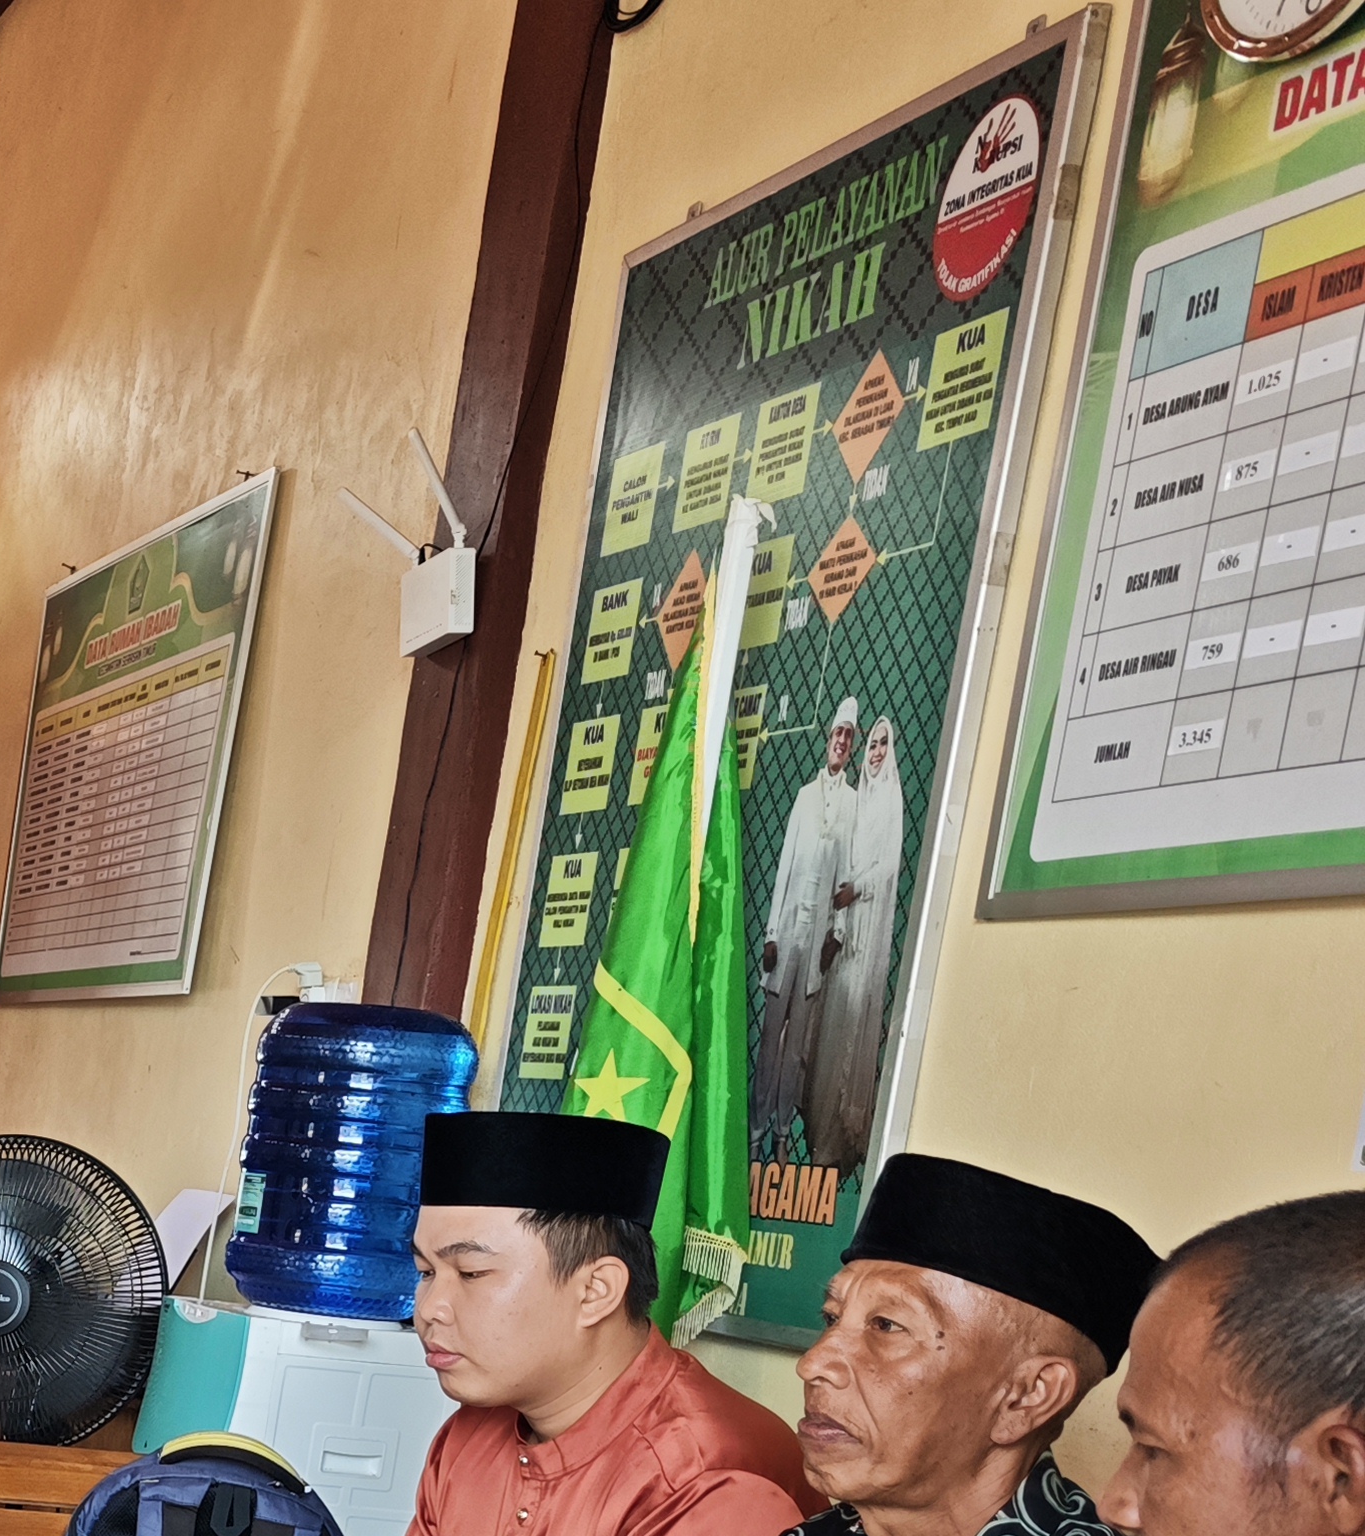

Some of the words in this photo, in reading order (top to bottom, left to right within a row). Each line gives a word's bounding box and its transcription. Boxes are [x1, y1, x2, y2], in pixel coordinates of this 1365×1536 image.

[1272, 48, 1365, 133] DATA
[944, 195, 966, 217] ZONA
[966, 169, 1015, 207] INTEGRITAS
[1015, 160, 1034, 183] KUA
[704, 222, 774, 310] ALUR
[774, 134, 949, 277] PELAYANAN
[937, 257, 958, 293] TOLAK
[957, 227, 1018, 294] GRATIFIKASI
[1317, 262, 1365, 303] KRISTEN
[736, 241, 887, 371] NIKAH
[1185, 285, 1220, 322] DESA
[1260, 284, 1297, 322] ISLAM
[956, 323, 986, 355] KUA
[1138, 310, 1154, 339] NO
[1246, 370, 1282, 396] 1.025
[768, 400, 791, 425] KANTOR
[790, 394, 807, 417] DESA
[1142, 401, 1167, 426] DESA
[1168, 390, 1201, 418] ARUNG
[1201, 380, 1231, 406] AYAM
[1126, 412, 1134, 431] 1
[623, 474, 648, 493] CALON
[1234, 460, 1259, 481] 875
[611, 488, 654, 512] PENGANTIN
[1133, 485, 1158, 510] DESA
[1159, 480, 1177, 501] AIR
[1177, 473, 1205, 496] NUSA
[620, 508, 639, 525] WALI
[1109, 498, 1118, 517] 2
[1217, 552, 1240, 573] 686
[1094, 582, 1103, 602] 3
[1125, 571, 1151, 595] DESA
[1150, 563, 1182, 588] PAYAK
[600, 588, 630, 613] BANK
[85, 637, 109, 667] DATA
[109, 619, 144, 657] RUMAH
[143, 602, 182, 642] IBADAH
[1098, 659, 1121, 682] DESA
[1122, 656, 1138, 677] AIR
[1139, 648, 1178, 674] RINGAU
[1201, 642, 1224, 661] 759
[1079, 667, 1087, 686] 4
[583, 724, 605, 746] KUA
[1178, 727, 1213, 749] 3.345
[1094, 740, 1132, 765] JUMLAH
[563, 858, 582, 880] KUA
[530, 995, 553, 1015] LOKASI
[552, 993, 574, 1014] NIKAH
[749, 1161, 839, 1227] AGAMA
[748, 1229, 795, 1271] IMUR
